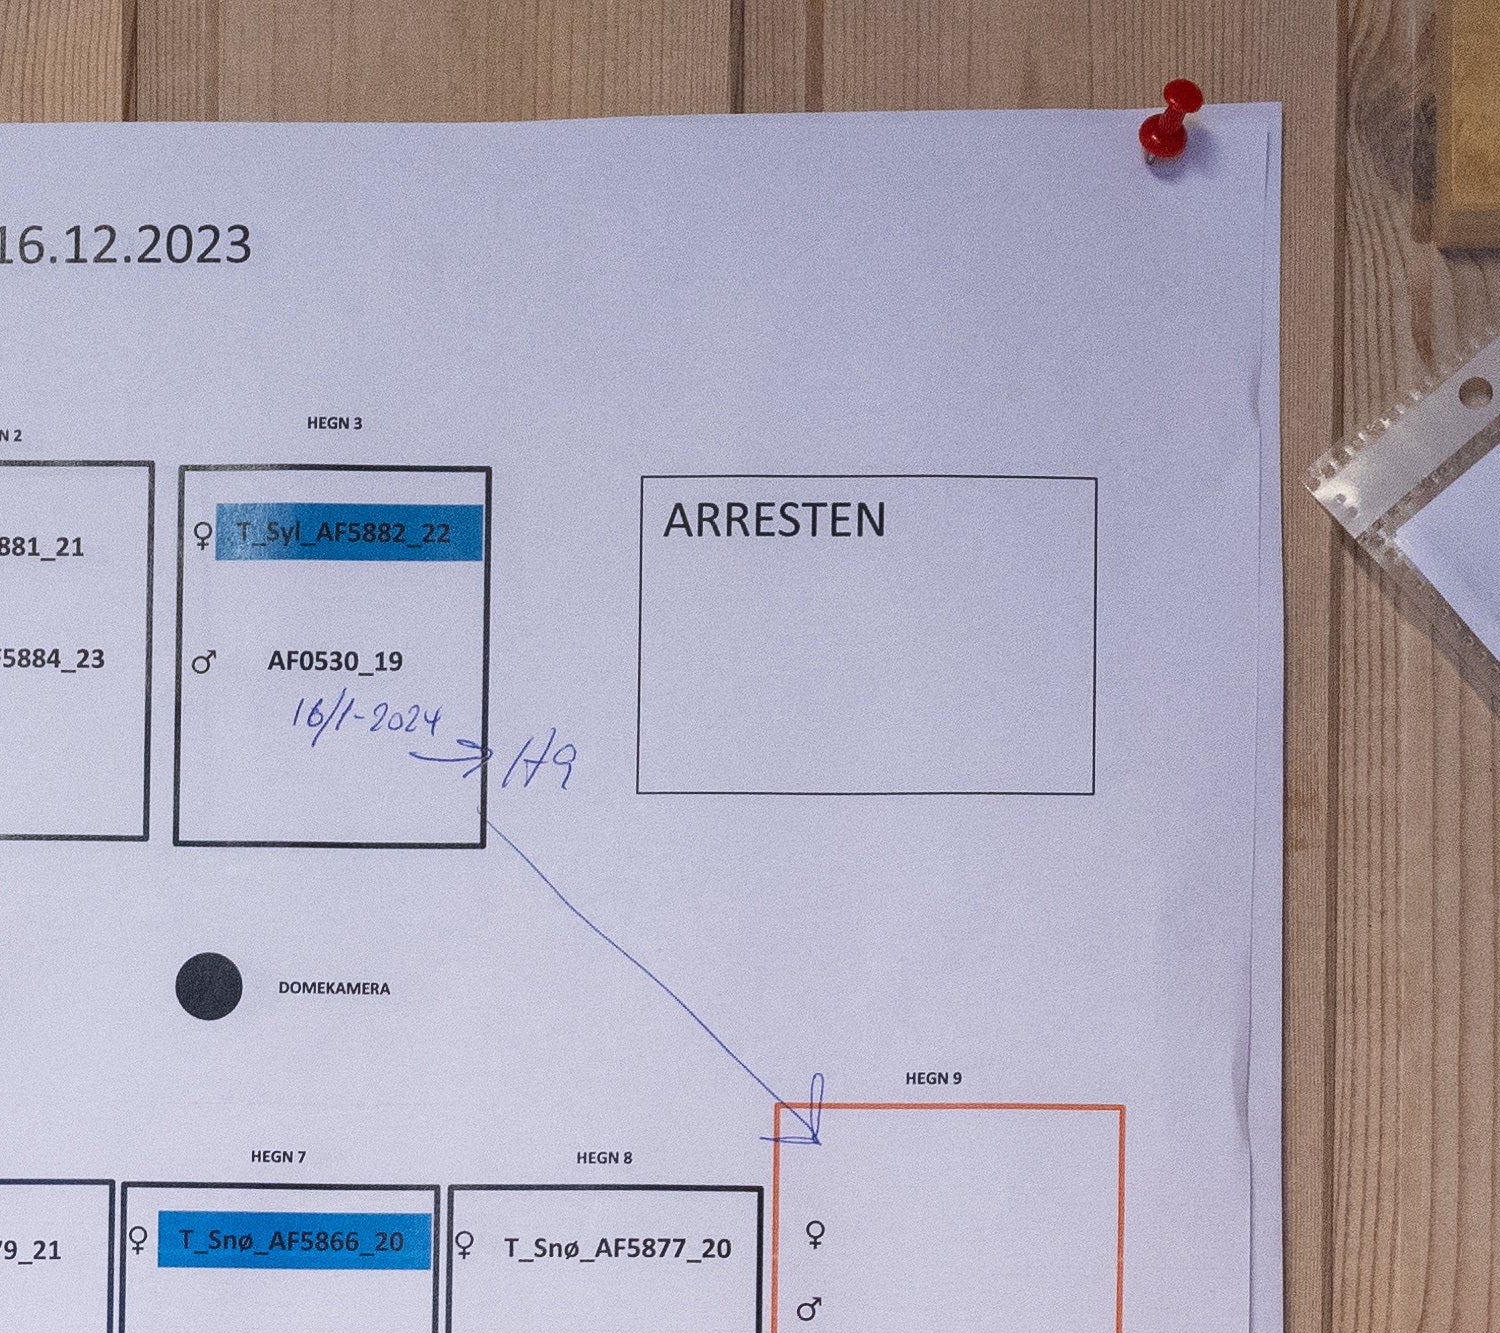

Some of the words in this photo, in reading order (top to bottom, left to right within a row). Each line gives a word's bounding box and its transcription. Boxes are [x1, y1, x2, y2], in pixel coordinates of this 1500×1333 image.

[307, 416, 350, 430] HEGN
[353, 416, 363, 431] 3
[663, 501, 885, 538] ARRESTEN
[267, 650, 403, 677] AF0530_19
[278, 981, 391, 996] DOMEKAMERA
[905, 1071, 949, 1086] HEGN
[952, 1071, 963, 1085] 9
[251, 1150, 294, 1164] HEGN
[297, 1150, 307, 1164] 7
[504, 1237, 732, 1264] T_Snø_AF5877_20
